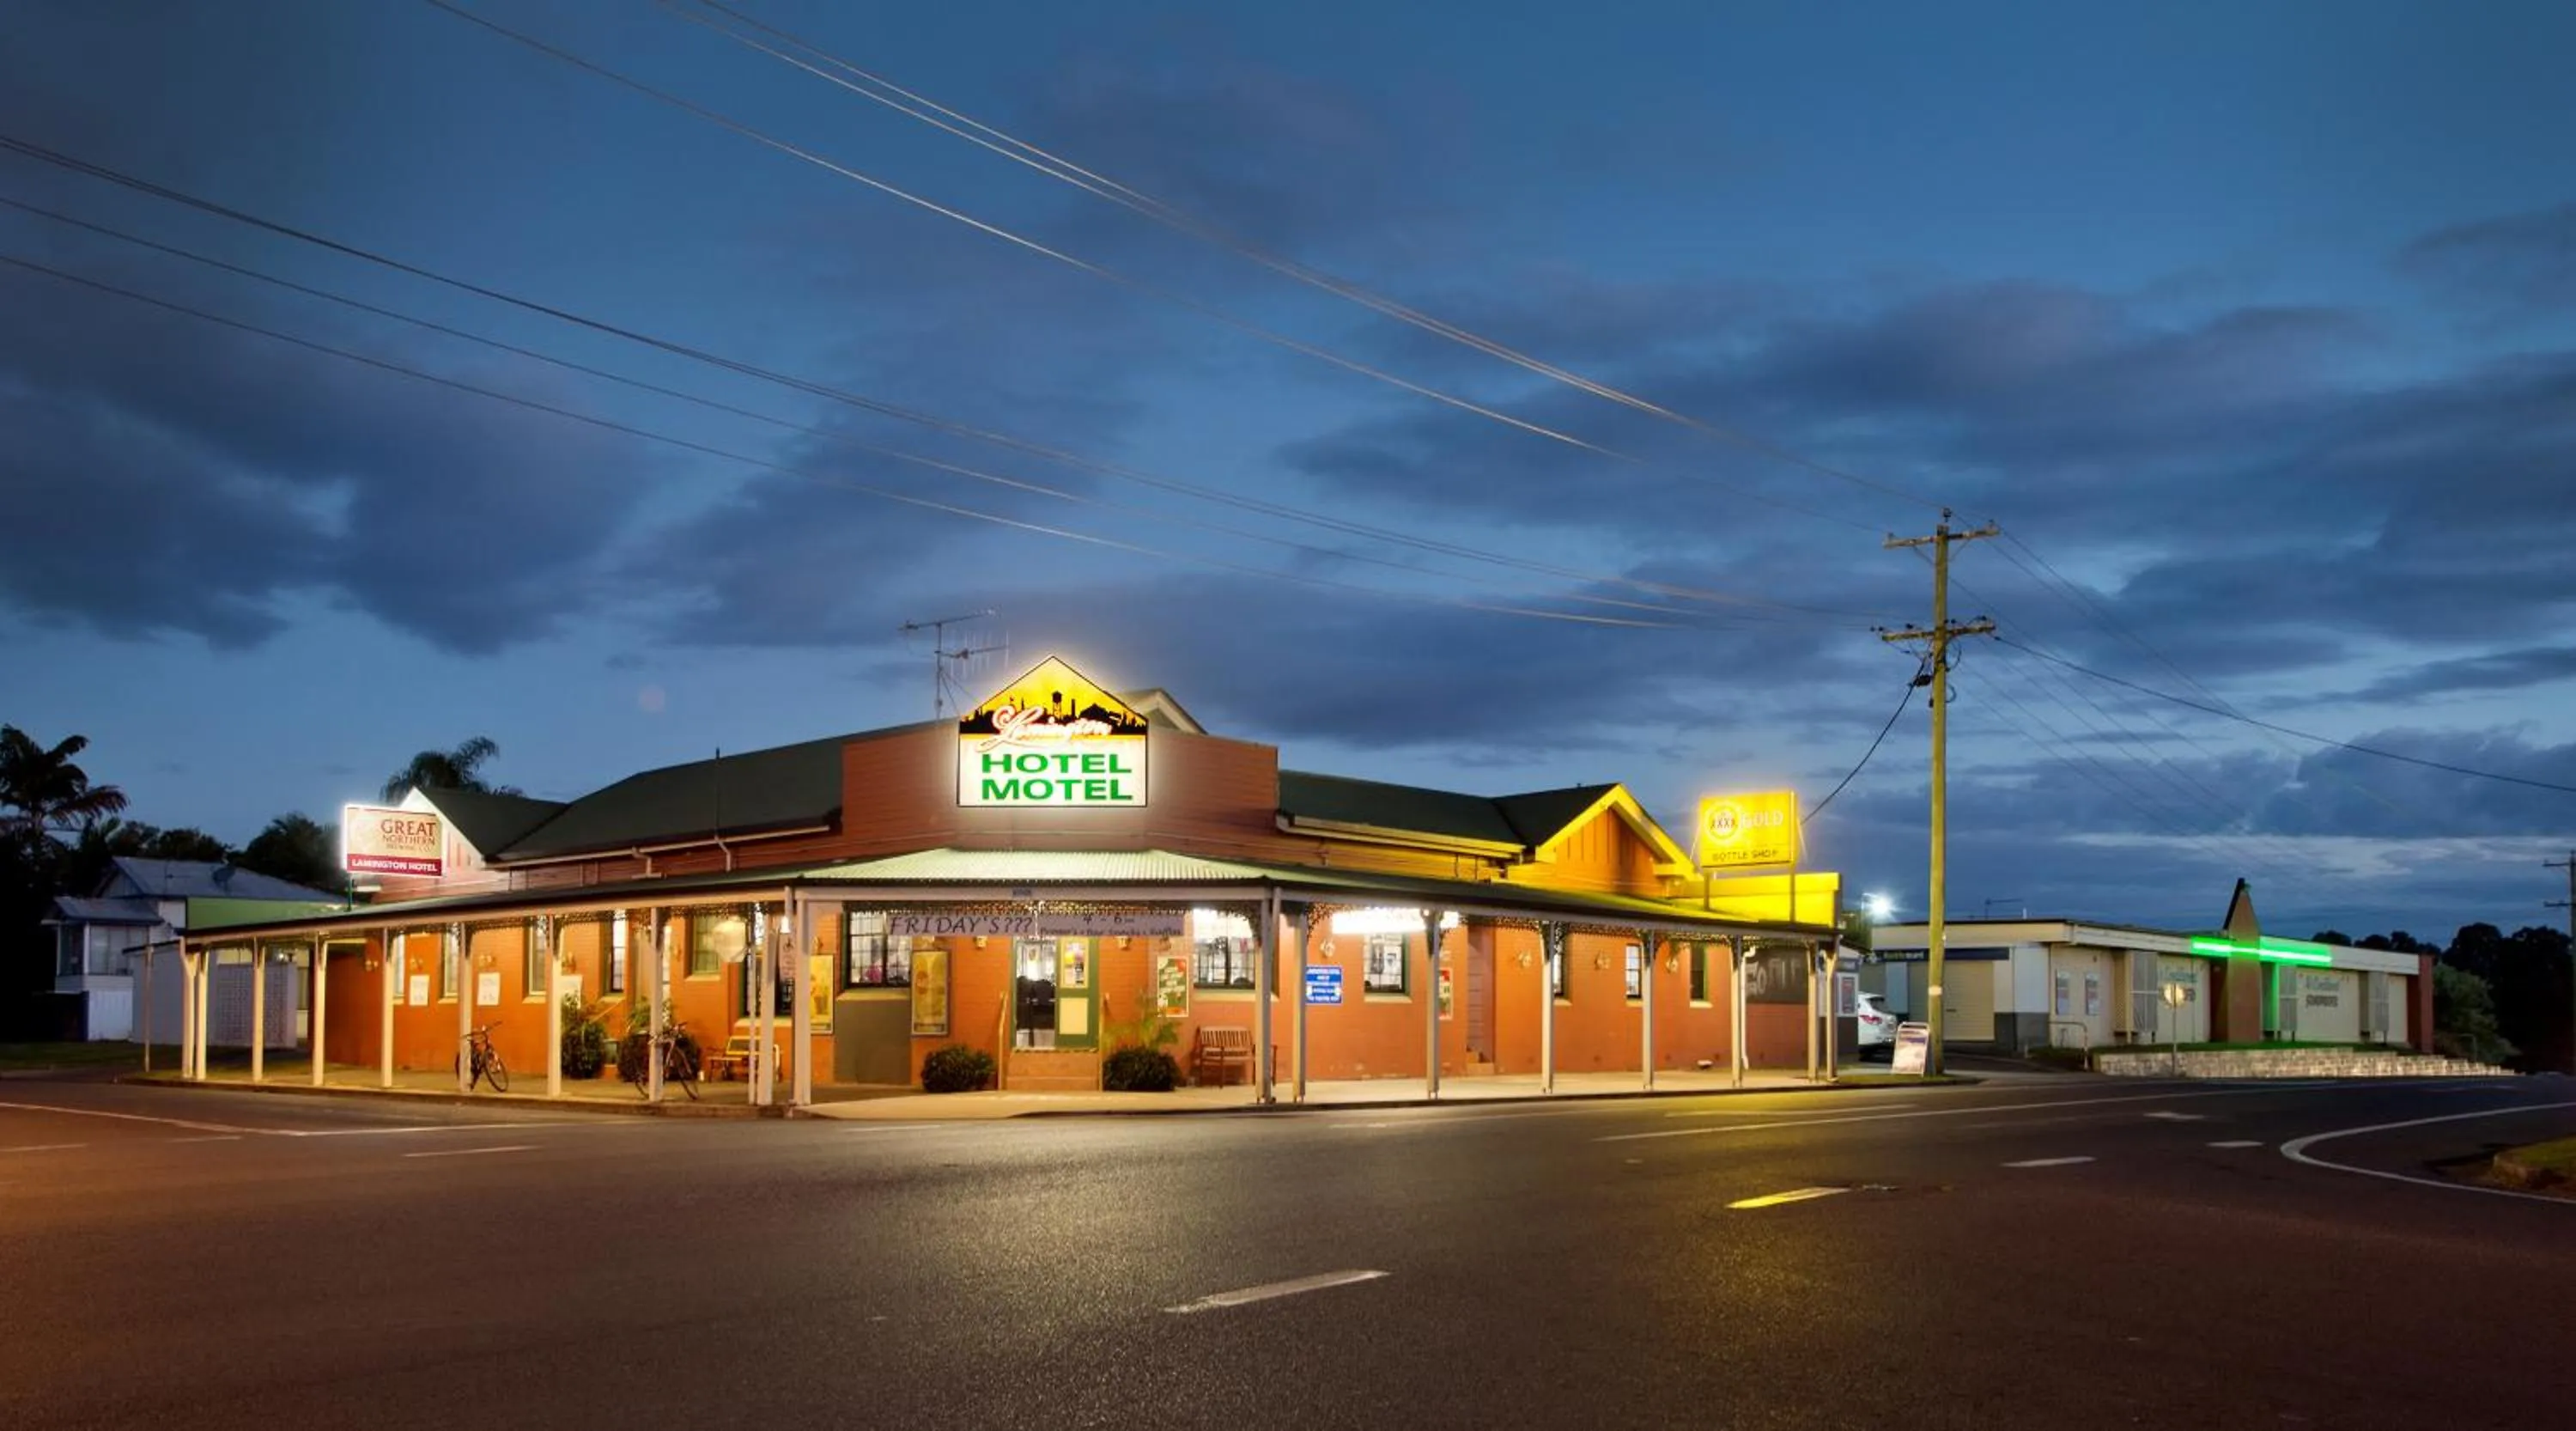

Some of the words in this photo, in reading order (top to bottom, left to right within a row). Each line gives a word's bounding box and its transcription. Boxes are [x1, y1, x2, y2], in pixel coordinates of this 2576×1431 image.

[981, 753, 1133, 774] HOTEL
[981, 778, 1133, 801] MOTEL
[380, 819, 436, 837] GREAT
[1741, 810, 1784, 828] GOLD
[382, 833, 435, 846] NORTHERN
[1712, 850, 1749, 862] BOTTLE
[1751, 849, 1779, 859] SHOP
[351, 858, 407, 870] LAMINGTON
[408, 862, 438, 872] HOTEL
